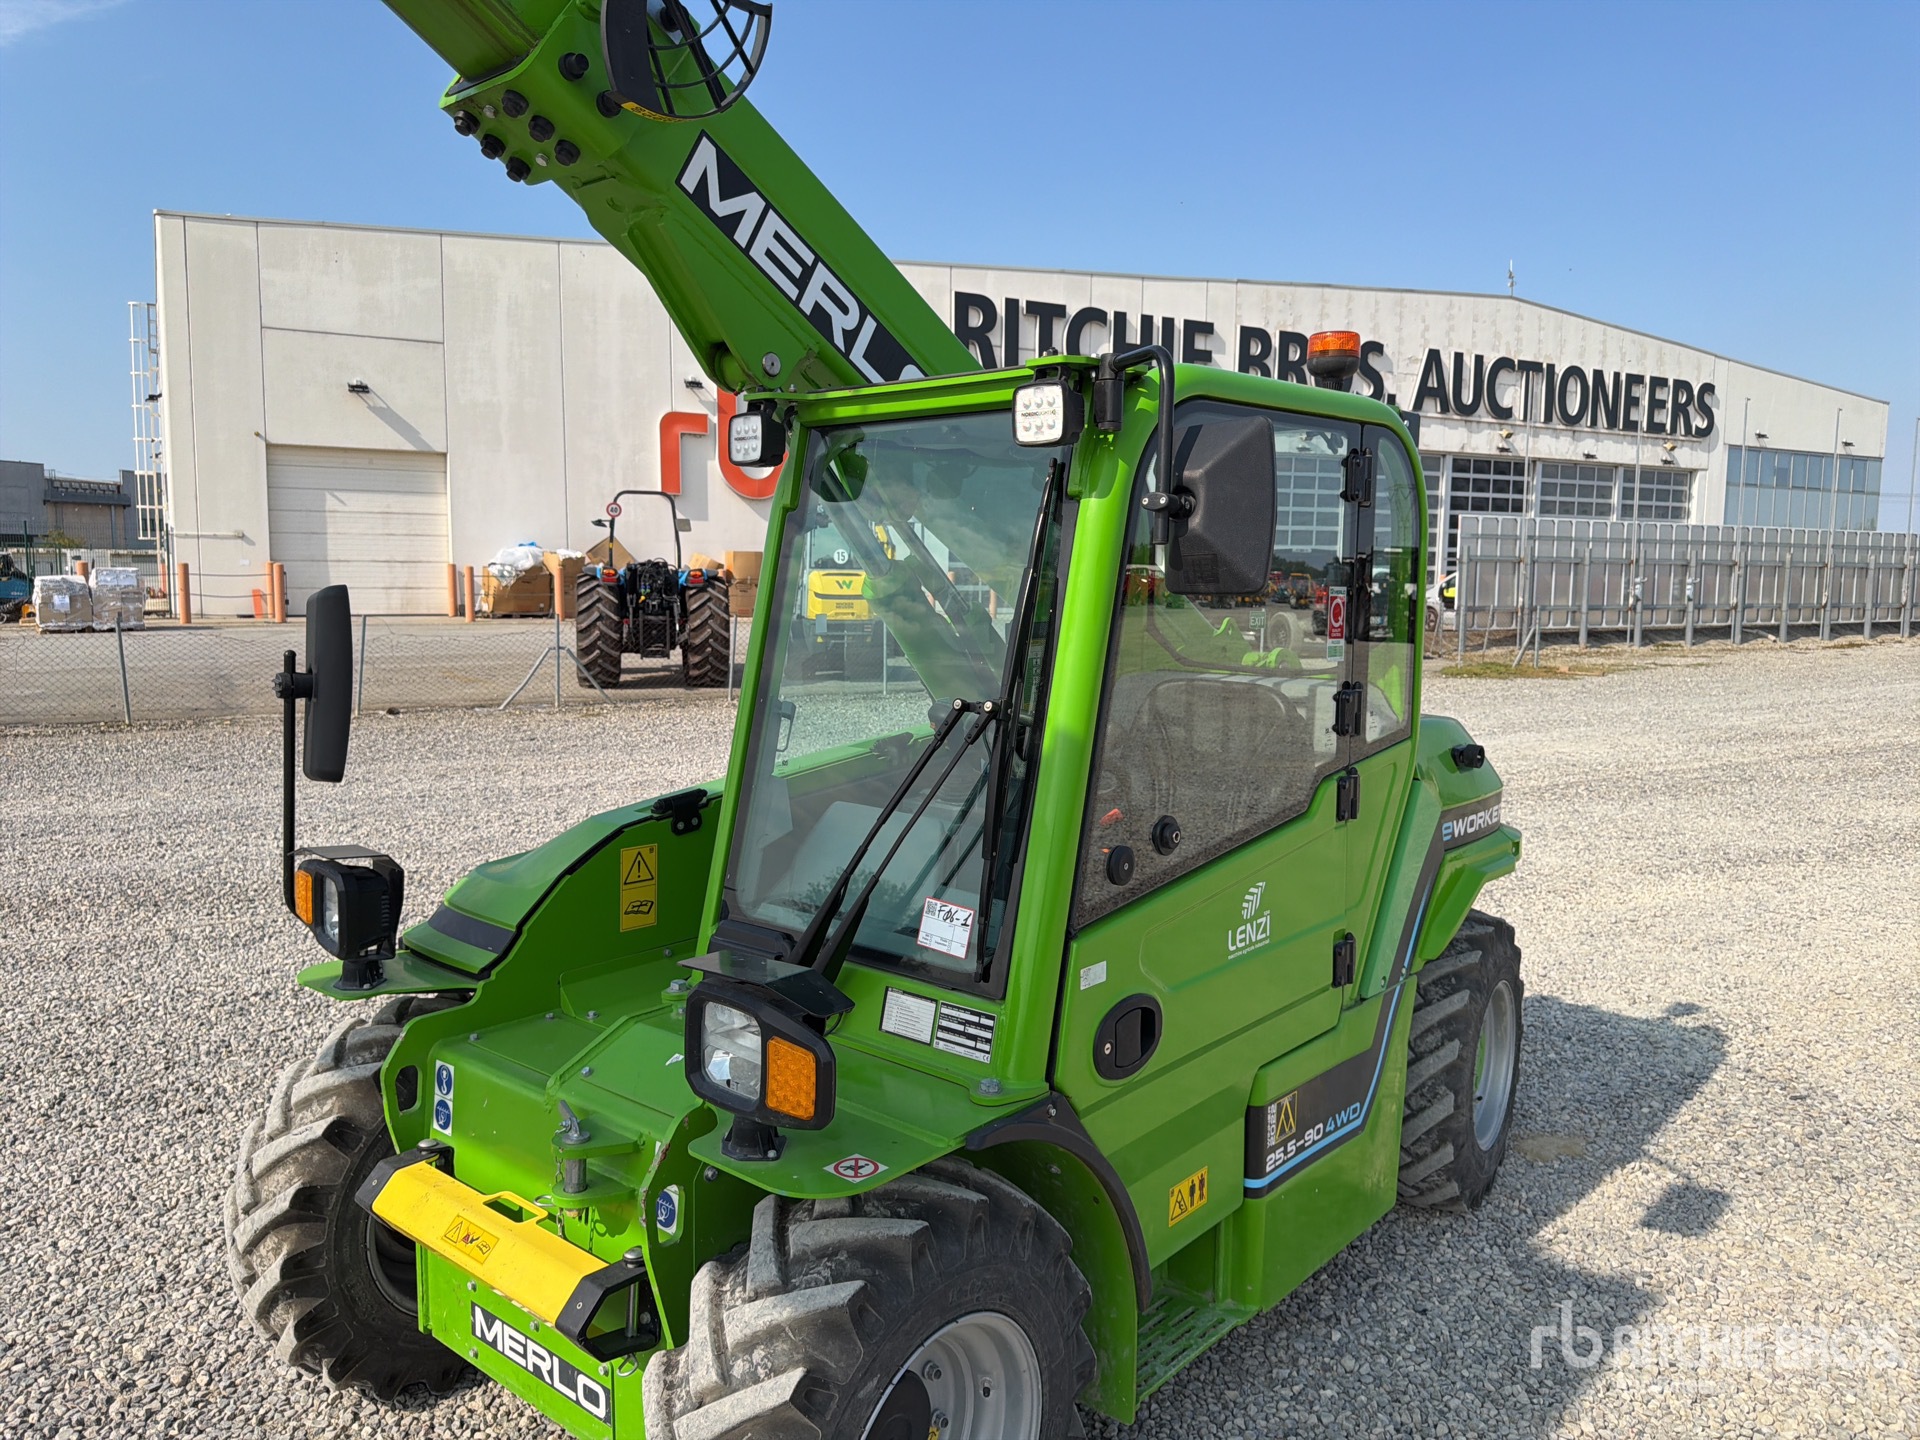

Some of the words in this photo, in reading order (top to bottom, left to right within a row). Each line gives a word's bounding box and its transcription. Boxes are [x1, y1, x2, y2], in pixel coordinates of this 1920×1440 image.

[1238, 325, 1396, 403] BRS.
[1411, 348, 1716, 438] AUCTIONEERS
[836, 551, 846, 562] 15
[1250, 616, 1265, 626] EXIT
[1442, 804, 1500, 842] eWORKE
[1228, 915, 1270, 952] LENZI
[1266, 1122, 1324, 1173] 25.5-90
[1325, 1102, 1361, 1134] 4WD
[473, 1305, 607, 1416] MERLO
